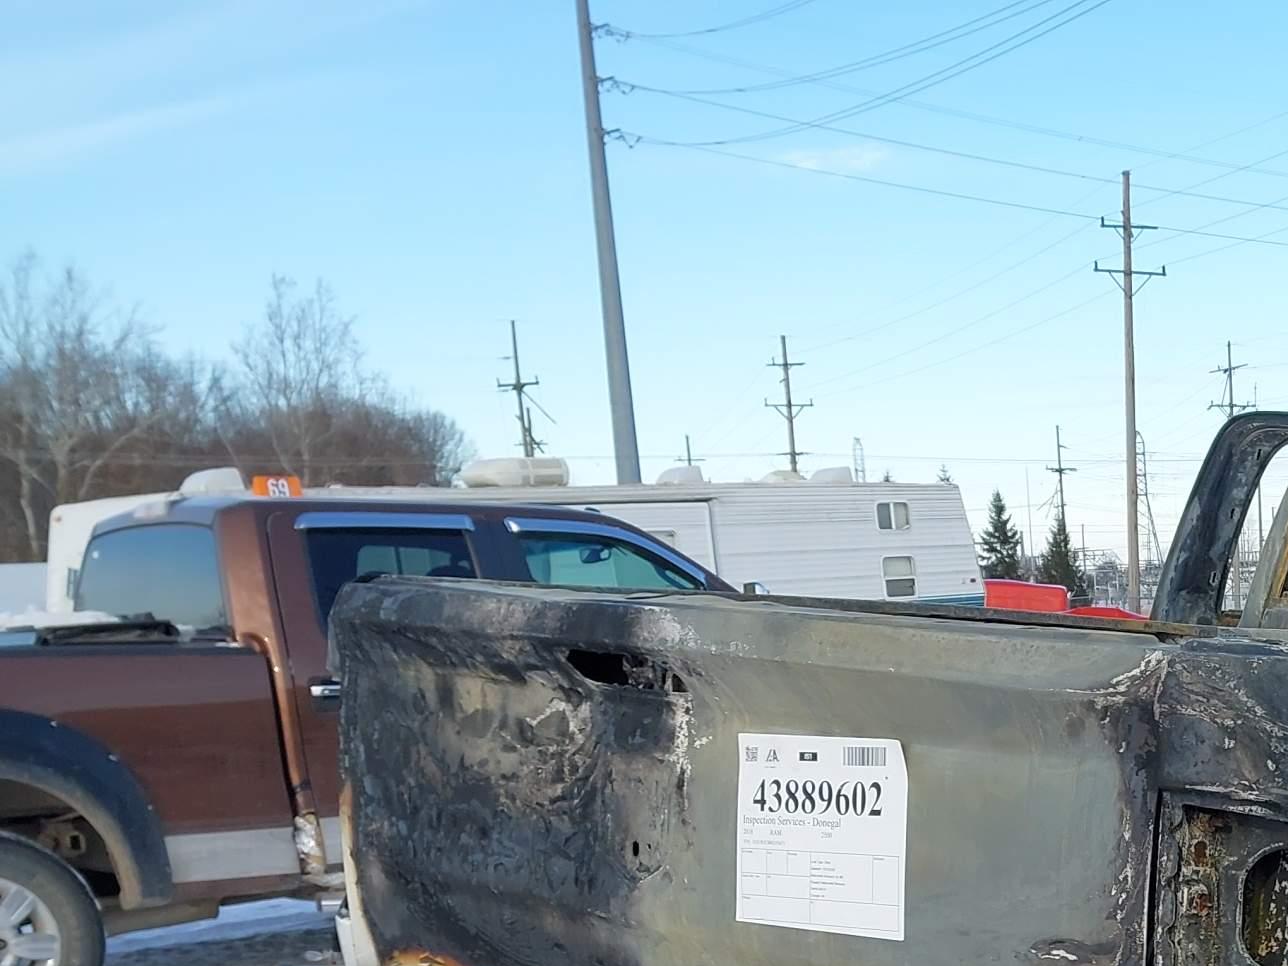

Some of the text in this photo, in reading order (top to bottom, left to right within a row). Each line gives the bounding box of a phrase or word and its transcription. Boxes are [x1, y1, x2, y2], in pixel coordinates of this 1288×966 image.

[266, 477, 289, 497] 69
[752, 778, 883, 817] 43889602
[743, 815, 776, 827] Inspection
[776, 816, 806, 827] Services
[812, 817, 842, 830] Donegal
